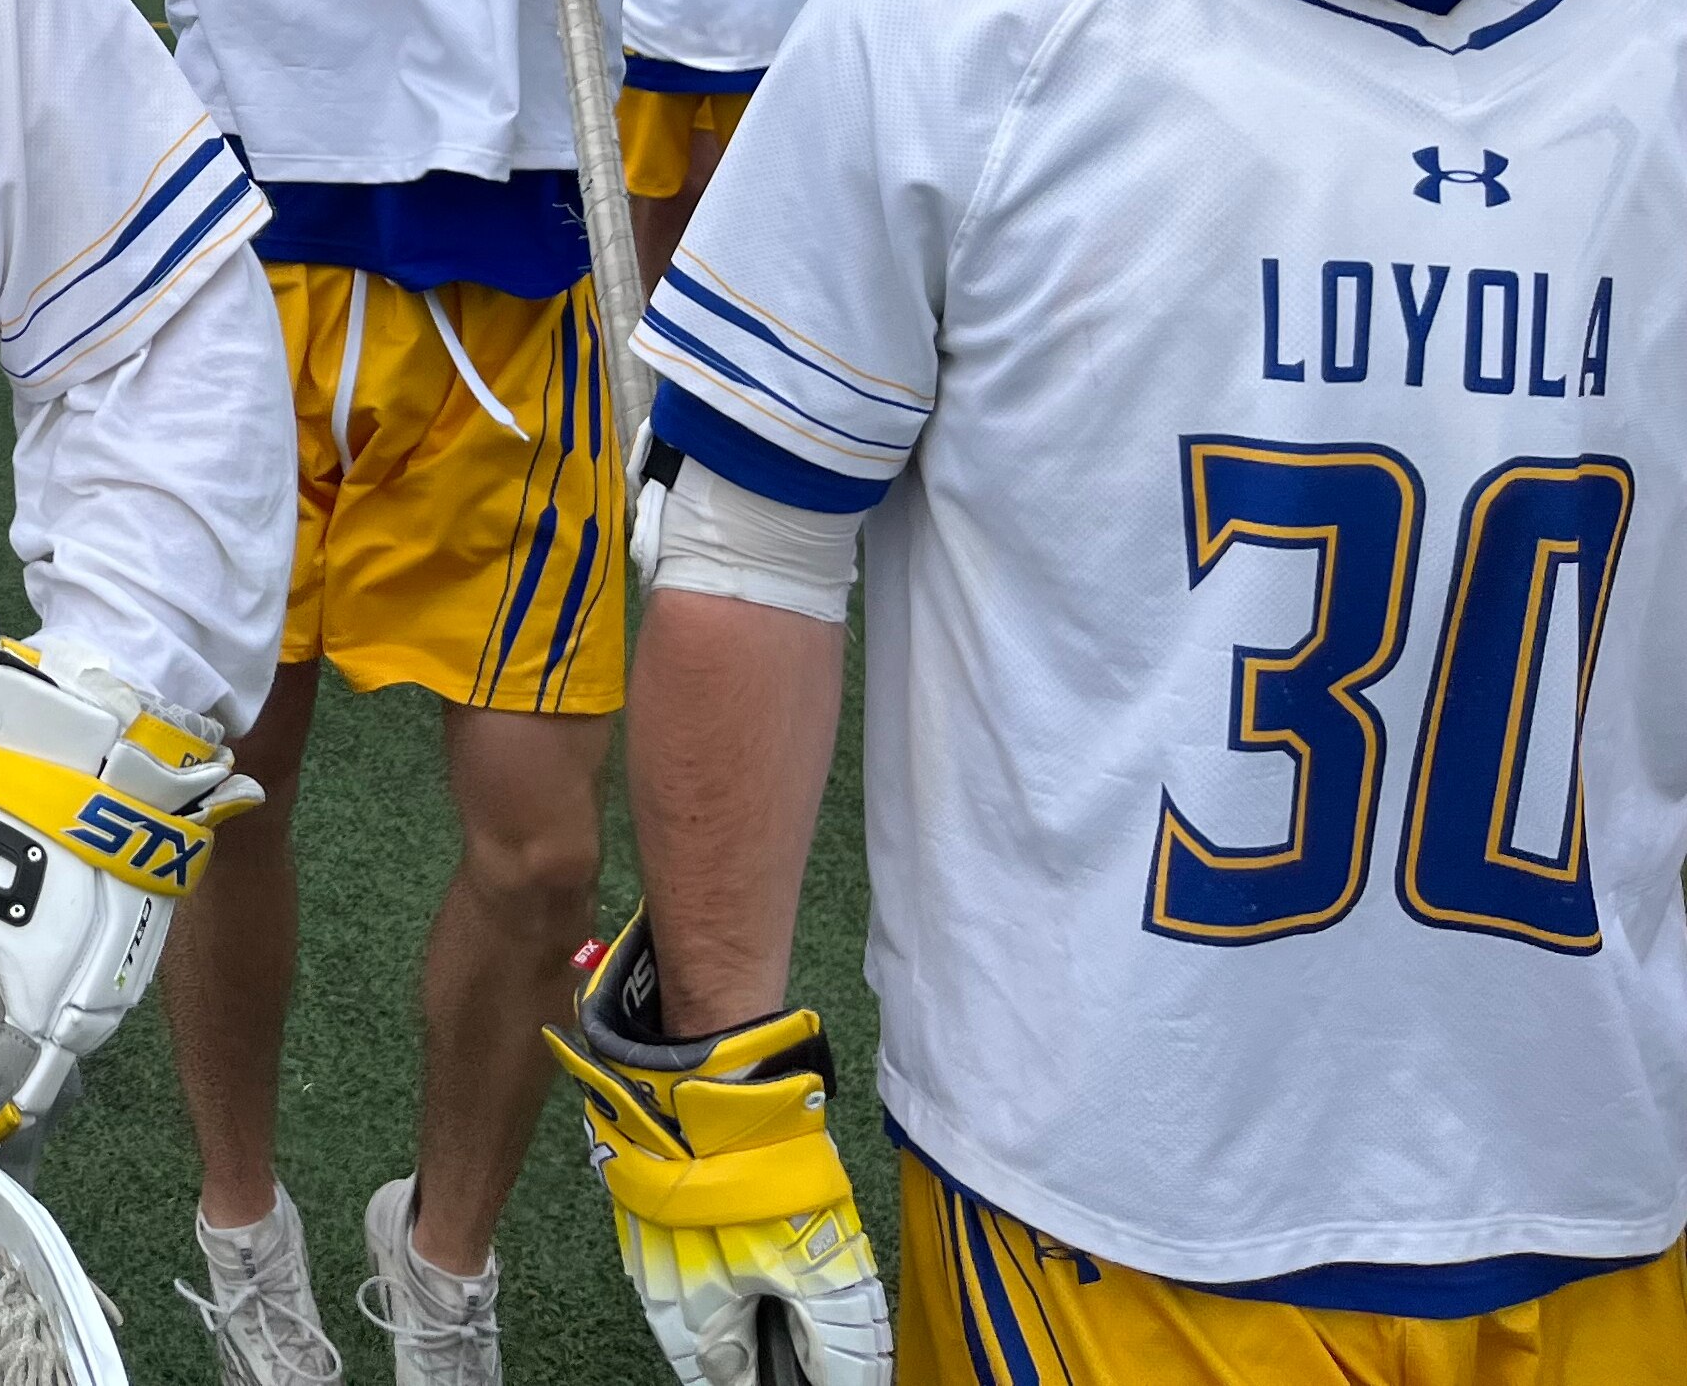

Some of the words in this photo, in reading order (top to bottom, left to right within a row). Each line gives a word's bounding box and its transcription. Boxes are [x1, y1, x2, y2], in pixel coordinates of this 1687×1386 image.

[1262, 257, 1613, 398] LOYOLA
[1141, 433, 1635, 957] 30
[62, 792, 208, 888] STX
